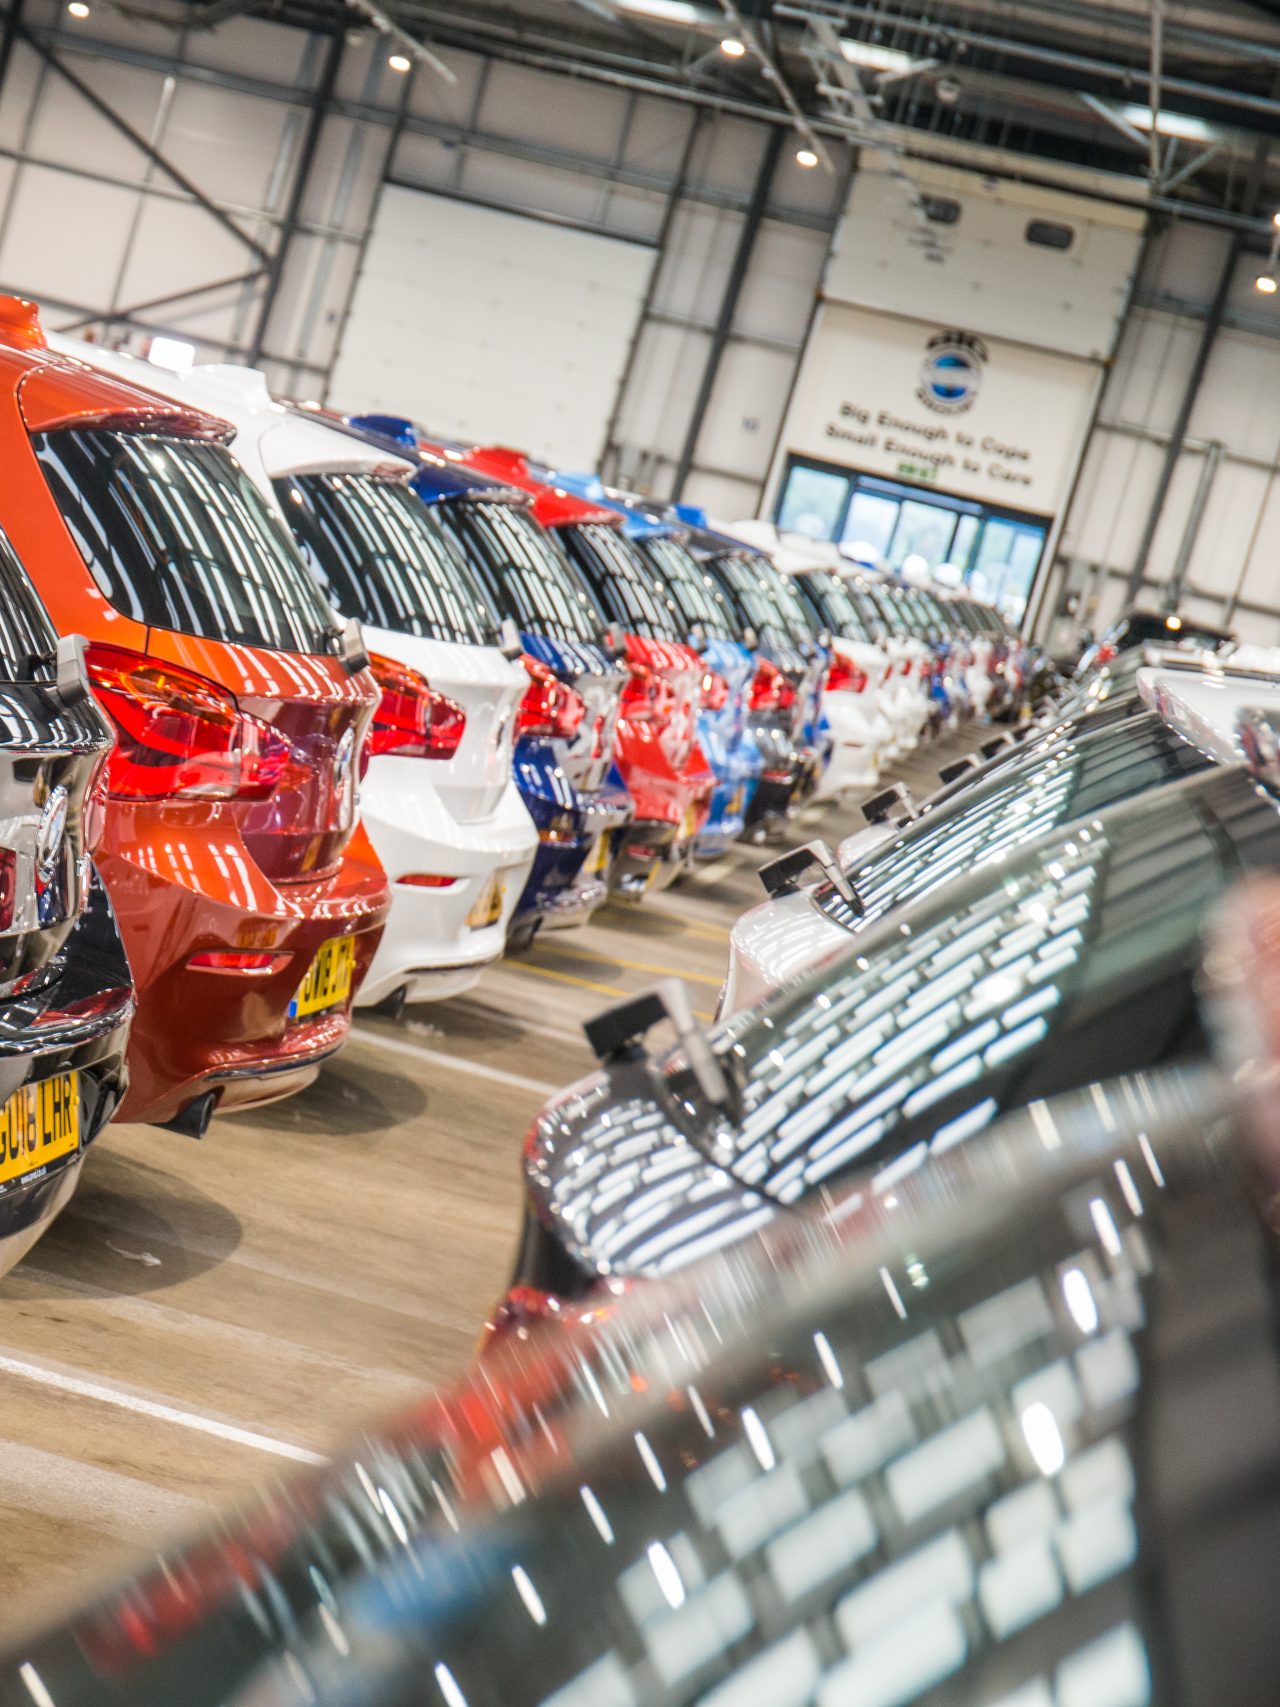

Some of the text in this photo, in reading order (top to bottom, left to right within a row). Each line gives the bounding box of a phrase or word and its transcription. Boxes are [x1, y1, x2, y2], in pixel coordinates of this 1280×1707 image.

[825, 422, 876, 447] Small
[884, 437, 956, 467] Enough
[963, 457, 980, 473] to
[988, 464, 1033, 487] Care
[840, 401, 1031, 462] Big Enough to Cope
[42, 1073, 73, 1146] LHR
